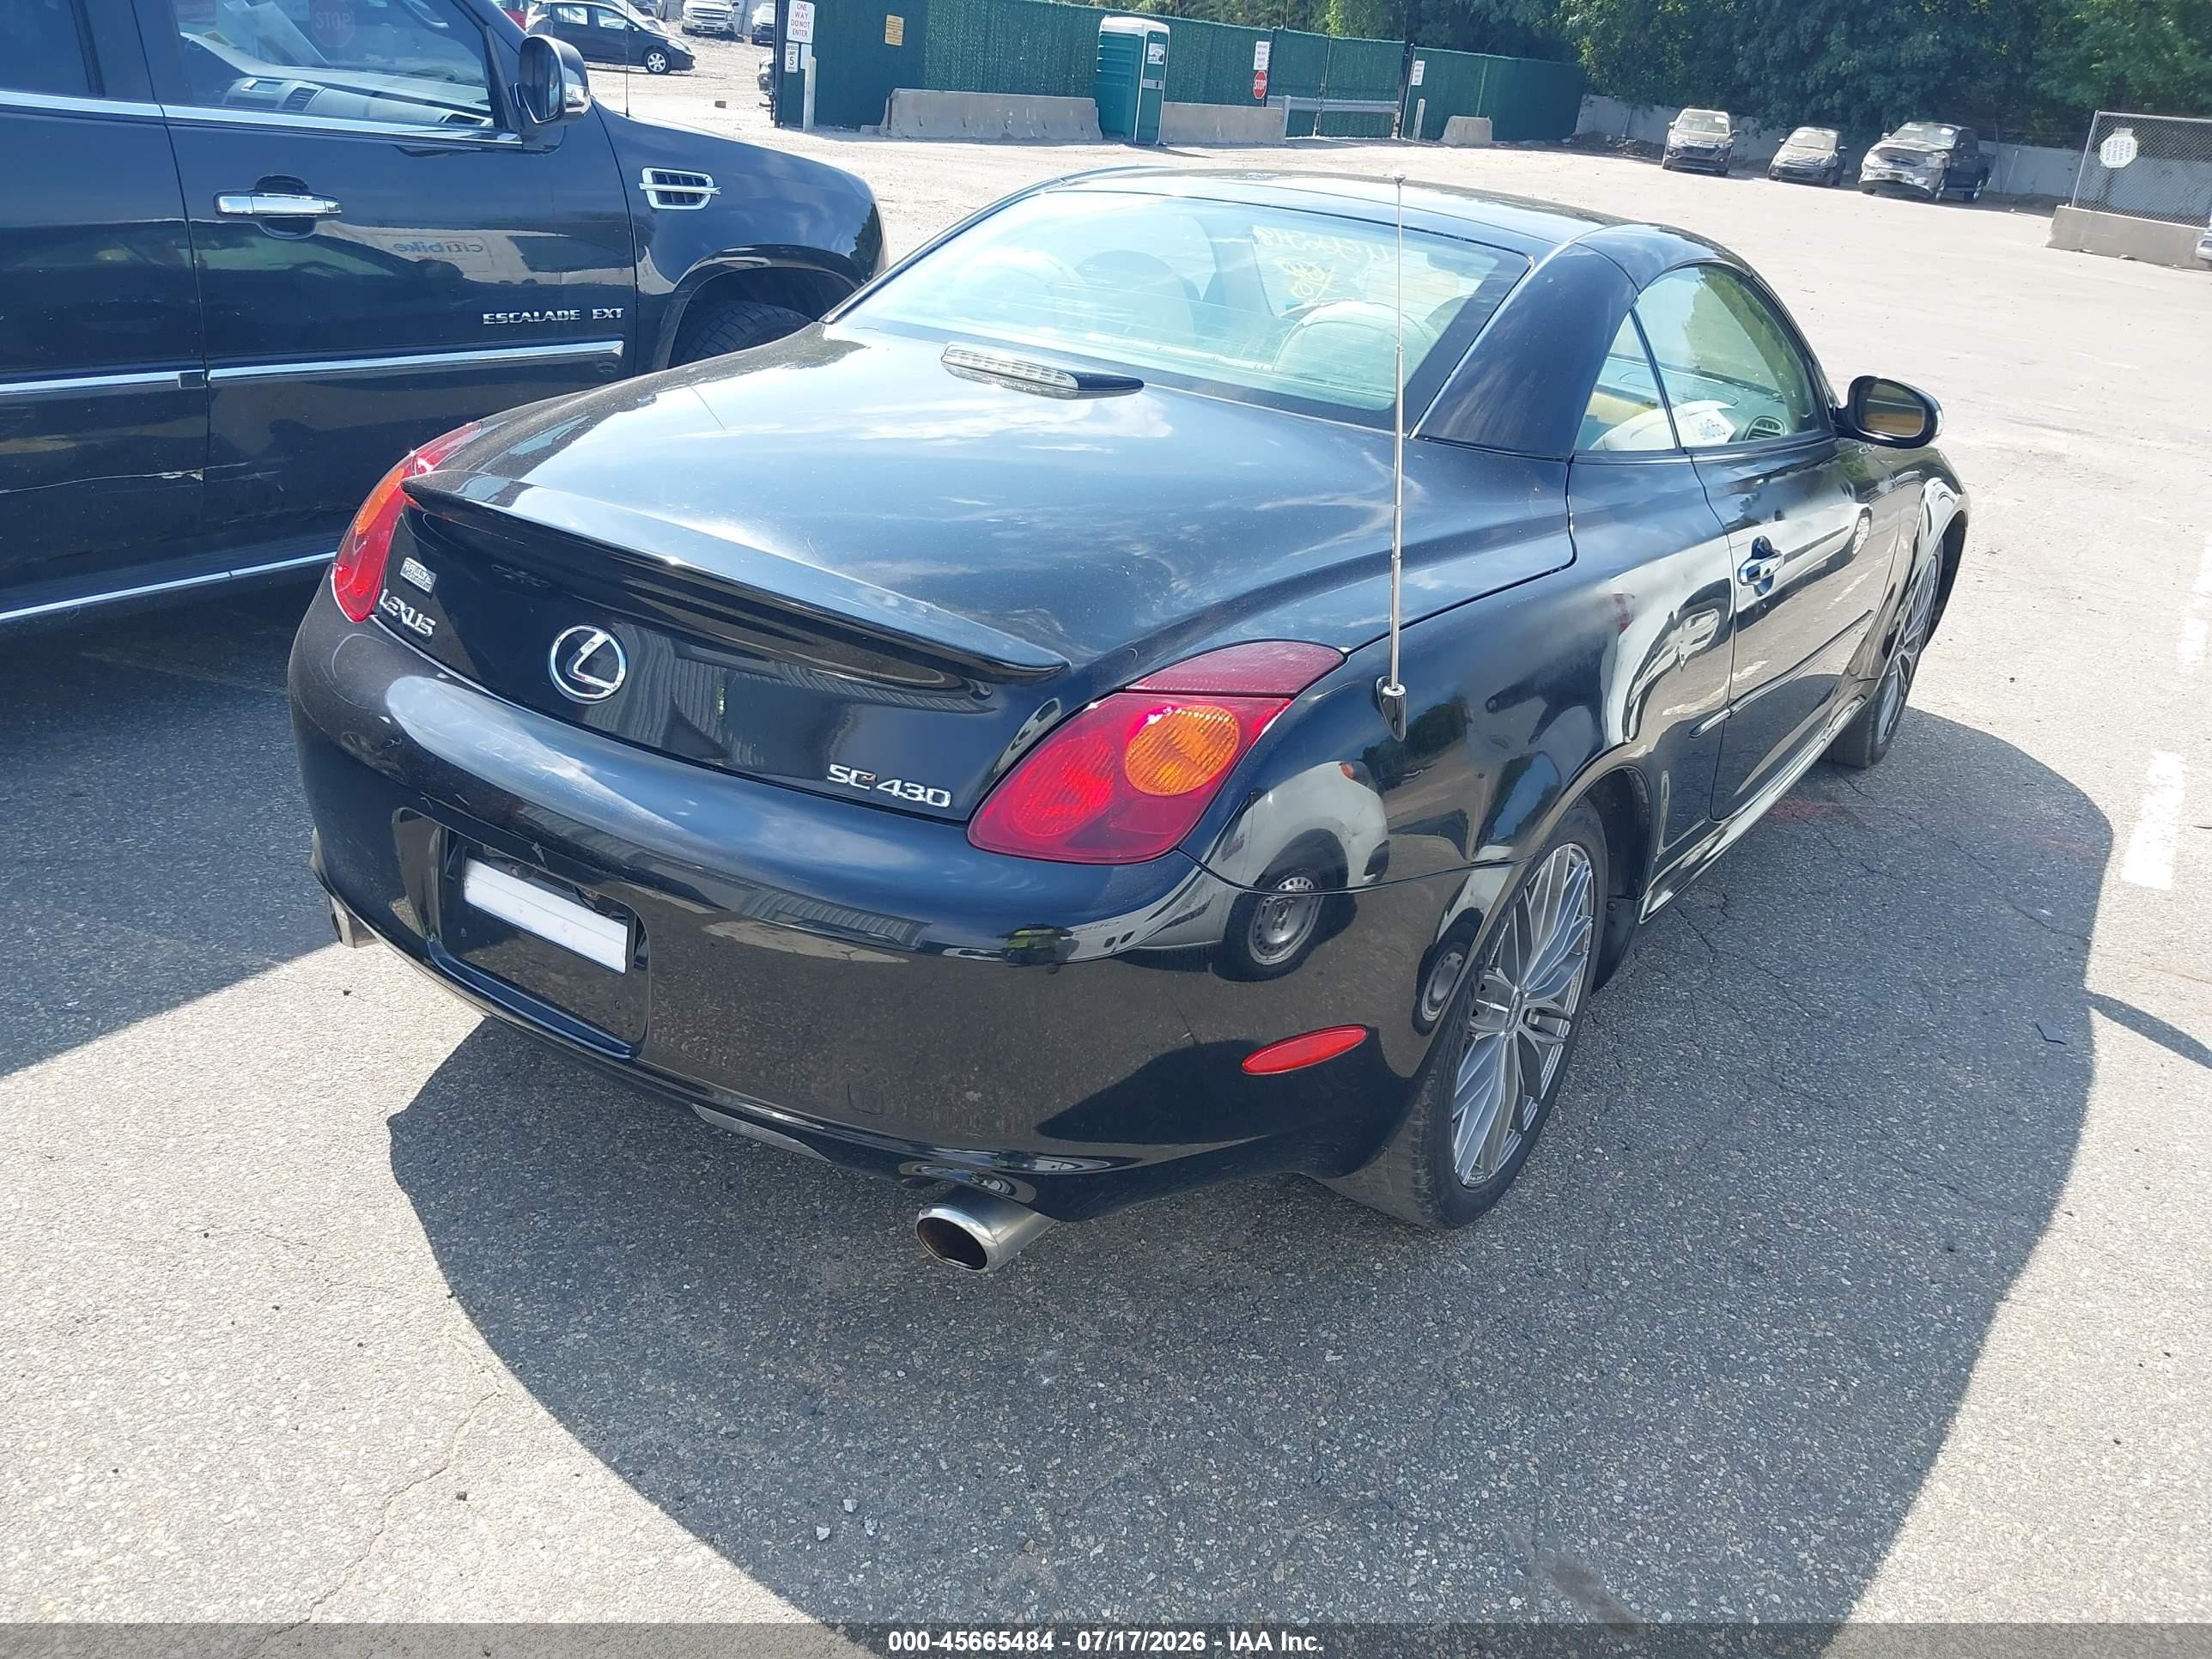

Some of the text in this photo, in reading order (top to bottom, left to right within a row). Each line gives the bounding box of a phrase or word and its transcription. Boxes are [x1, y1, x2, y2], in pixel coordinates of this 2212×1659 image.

[315, 11, 351, 29] STOP
[793, 28, 807, 37] ENTER
[790, 56, 794, 65] 5
[1254, 79, 1267, 90] STOP
[483, 307, 625, 325] ESCALADE EXT
[379, 588, 436, 637] LEXUS
[827, 763, 951, 808] SC 430
